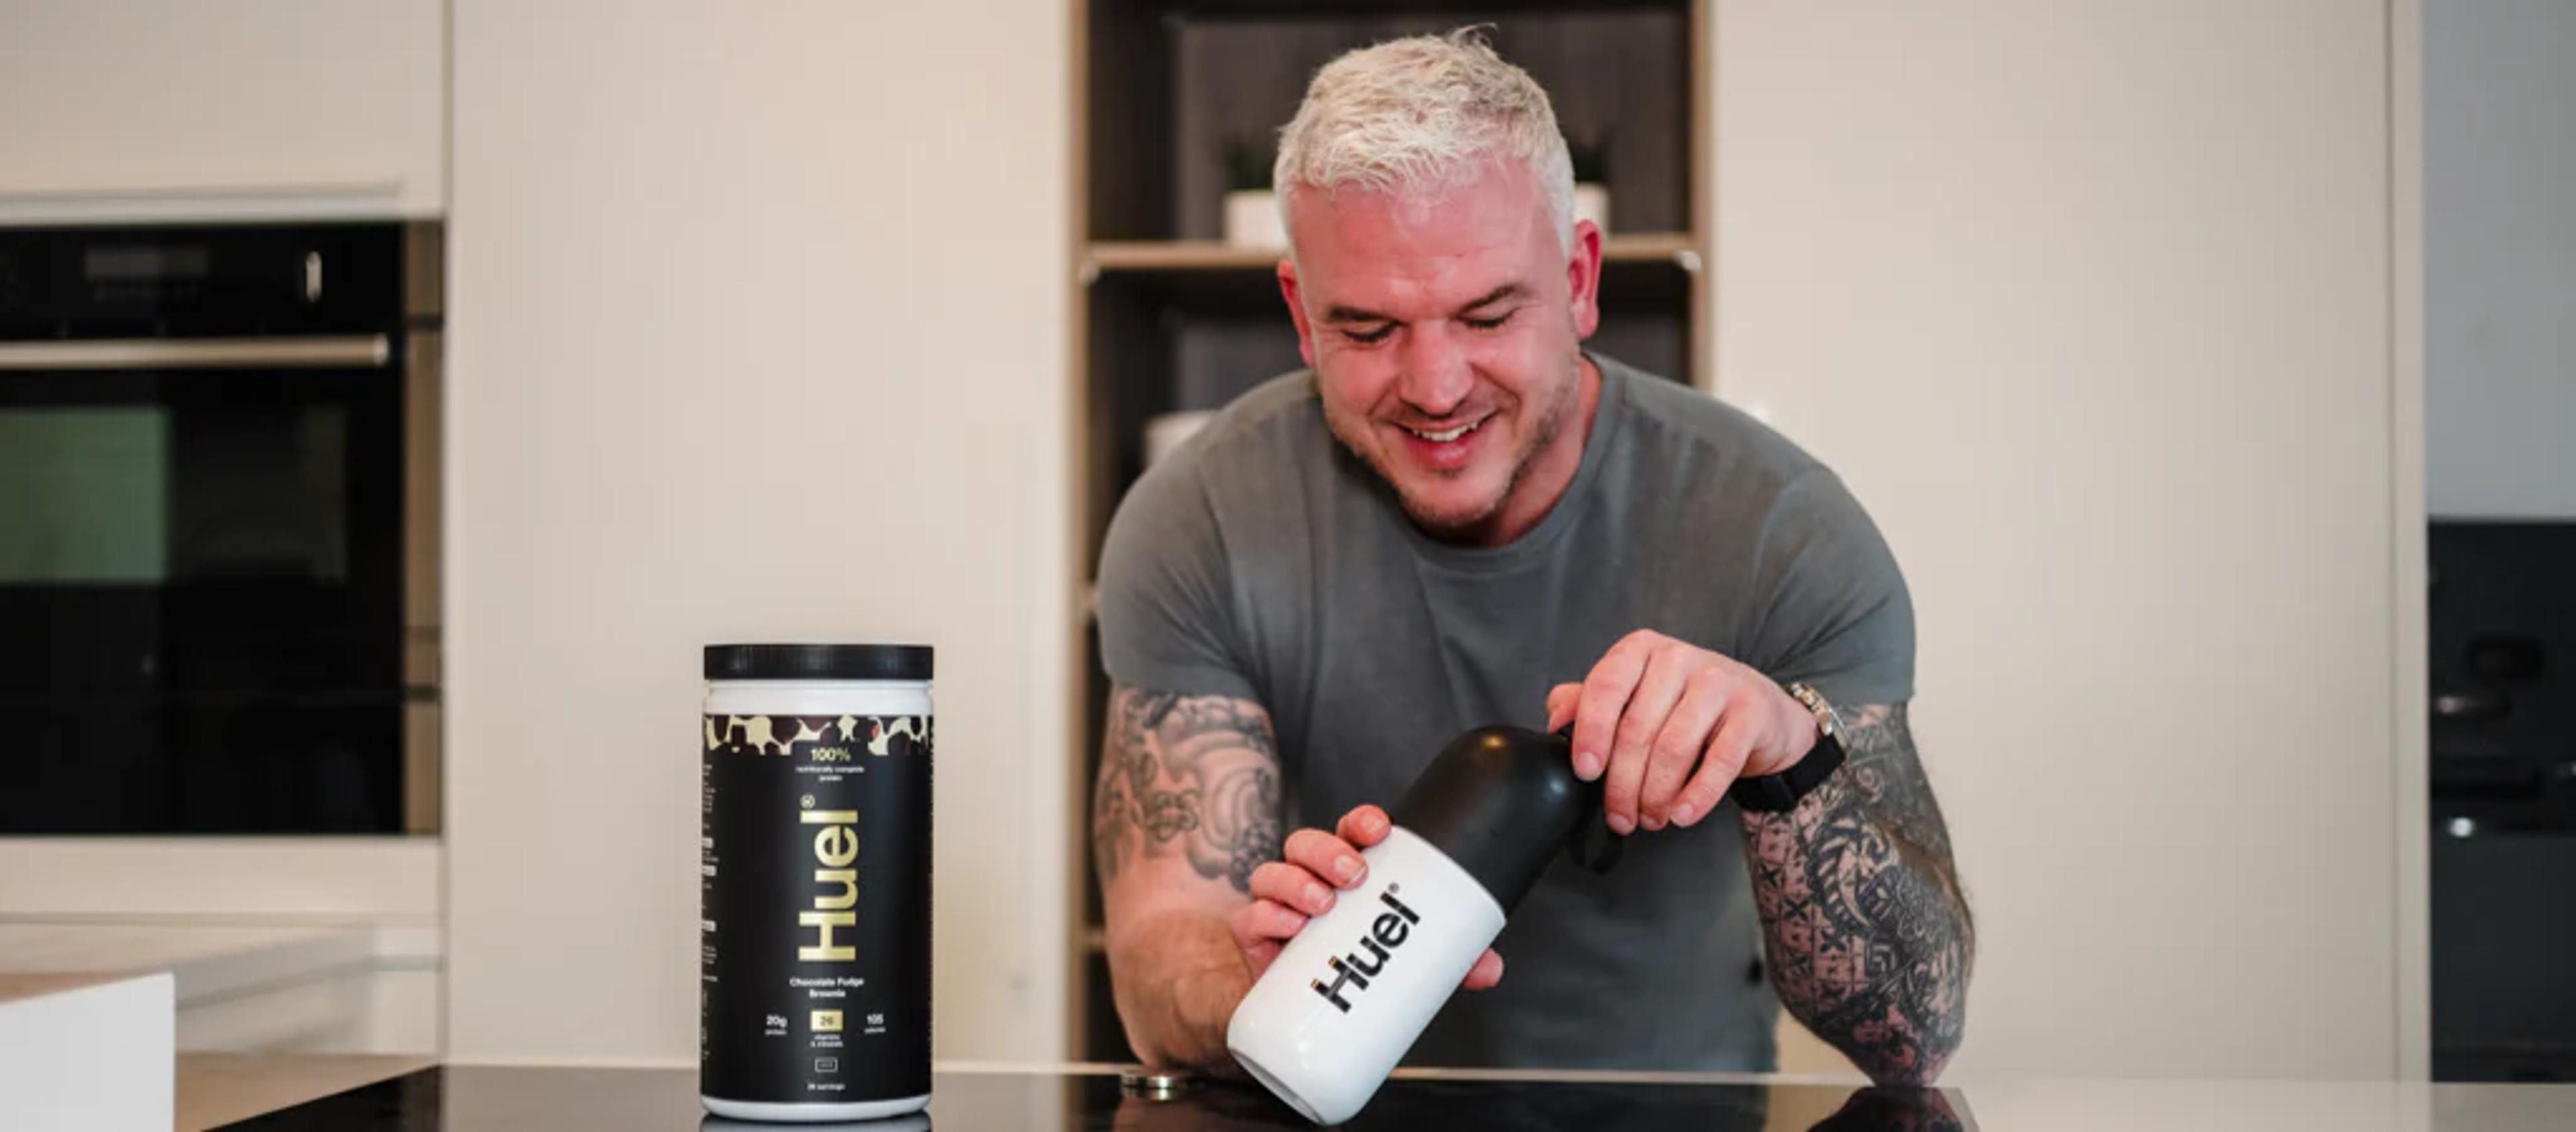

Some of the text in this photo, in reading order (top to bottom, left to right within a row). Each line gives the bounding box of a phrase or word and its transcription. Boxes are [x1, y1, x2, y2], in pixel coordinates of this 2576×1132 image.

[810, 747, 851, 761] 100%
[790, 976, 863, 986] Chocolate Fudge
[766, 1015, 788, 1027] 20g
